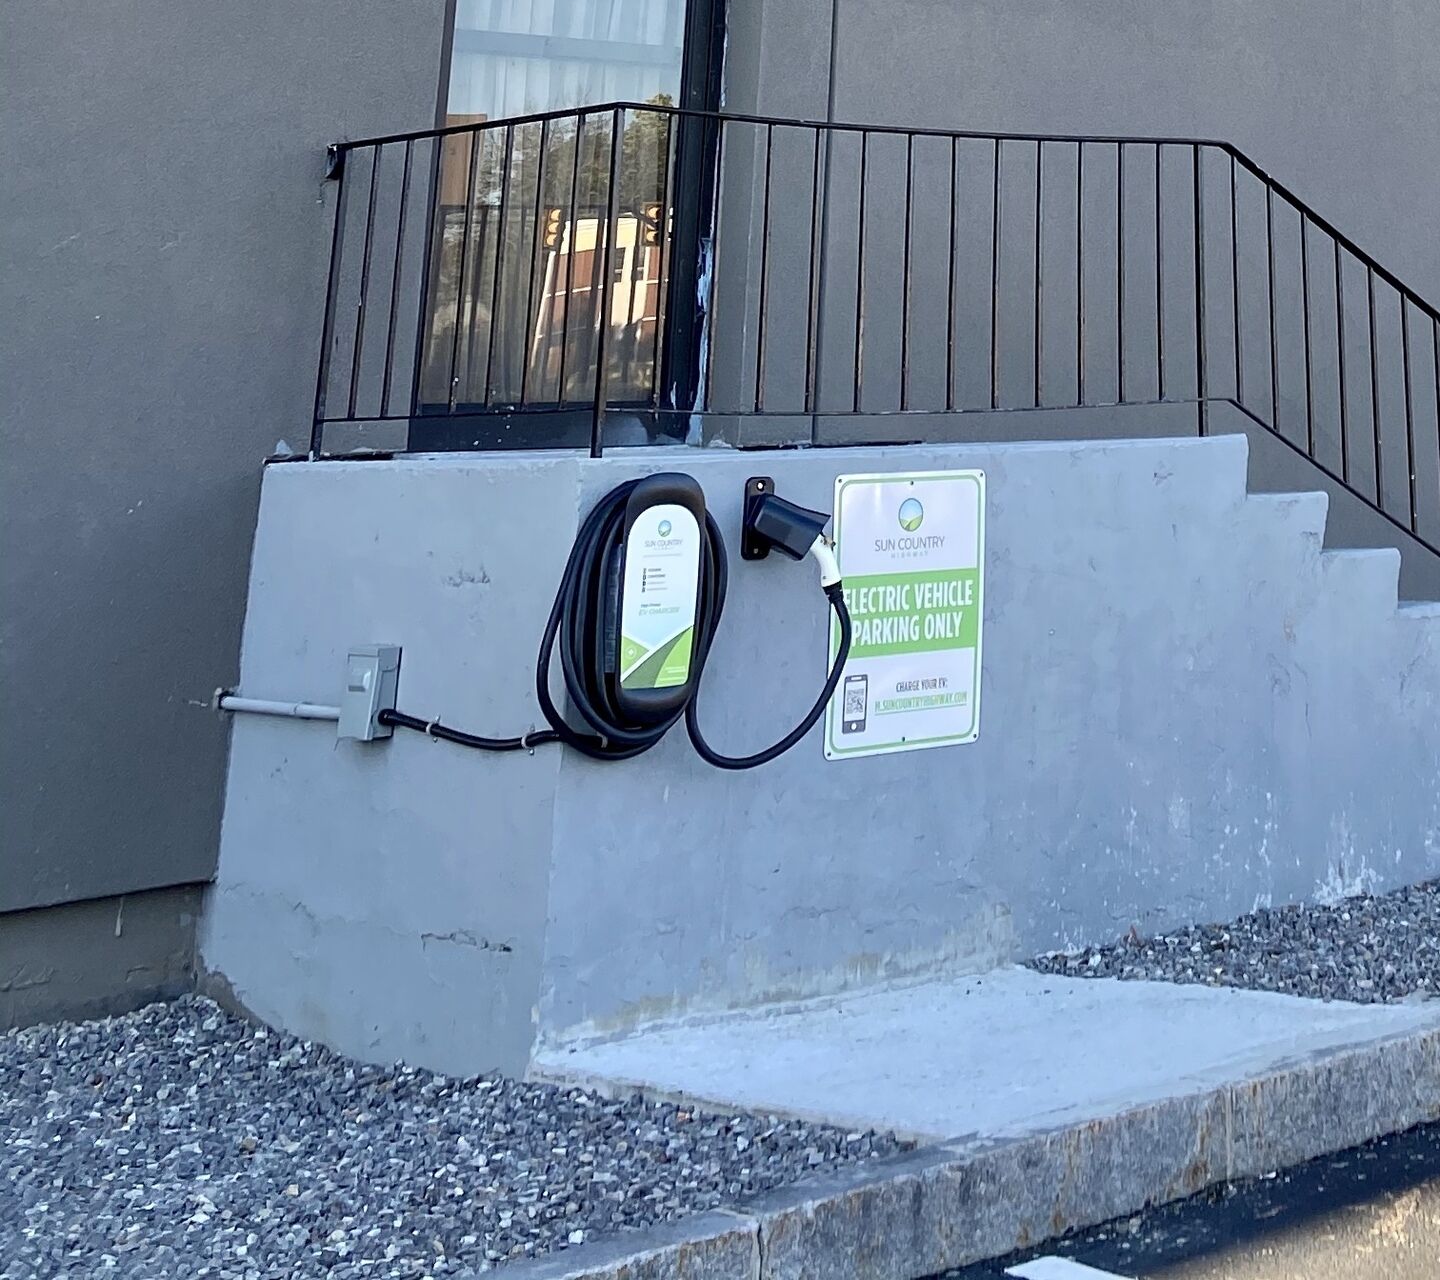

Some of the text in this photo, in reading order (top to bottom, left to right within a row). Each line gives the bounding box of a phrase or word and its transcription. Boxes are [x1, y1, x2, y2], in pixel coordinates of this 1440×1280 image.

[875, 535, 945, 552] SUN COUNTRY
[914, 579, 974, 610] VEHICLE
[850, 611, 963, 648] PARKING ONLY
[896, 680, 920, 693] CHARGE
[921, 678, 938, 691] YOUR
